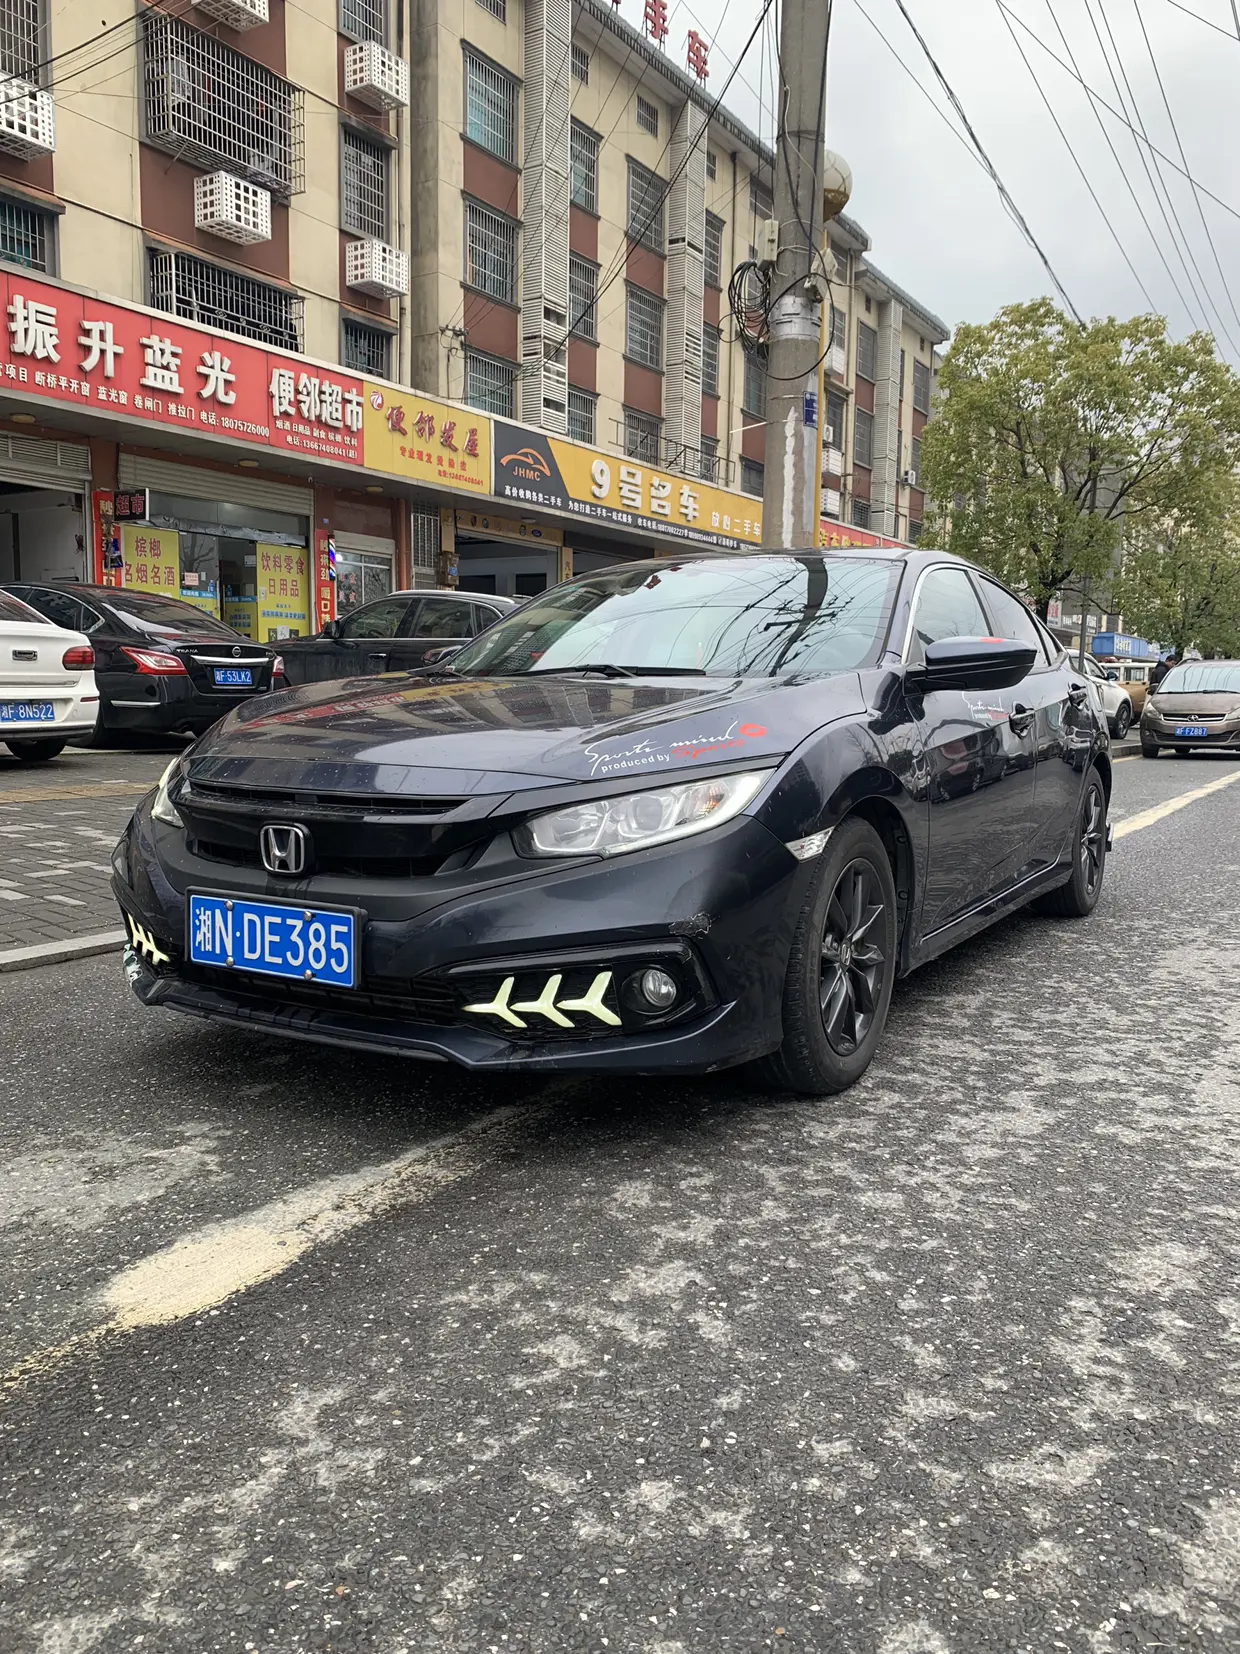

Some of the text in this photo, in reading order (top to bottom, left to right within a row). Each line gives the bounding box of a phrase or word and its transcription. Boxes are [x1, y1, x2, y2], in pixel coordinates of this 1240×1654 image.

[7, 294, 237, 405] 振升蓝光
[0, 362, 28, 383] 项目
[35, 371, 90, 397] 断桥平开窗
[97, 385, 128, 406] 蓝光窗
[134, 394, 162, 413] 卷闸门
[168, 401, 195, 420] 推拉门
[269, 368, 364, 432] 便邻超市
[512, 466, 541, 481] JHMC
[504, 484, 562, 507] 高价收购各类二手车
[590, 459, 700, 521] 9号名车
[115, 494, 145, 516] 超市
[135, 536, 162, 560] 槟榔
[125, 562, 175, 587] 名烟名酒
[261, 551, 305, 576] 饮料零食
[268, 577, 300, 598] 日用品
[601, 756, 655, 773] produced
[657, 753, 671, 763] by
[195, 906, 349, 974] 湘N·DE385
